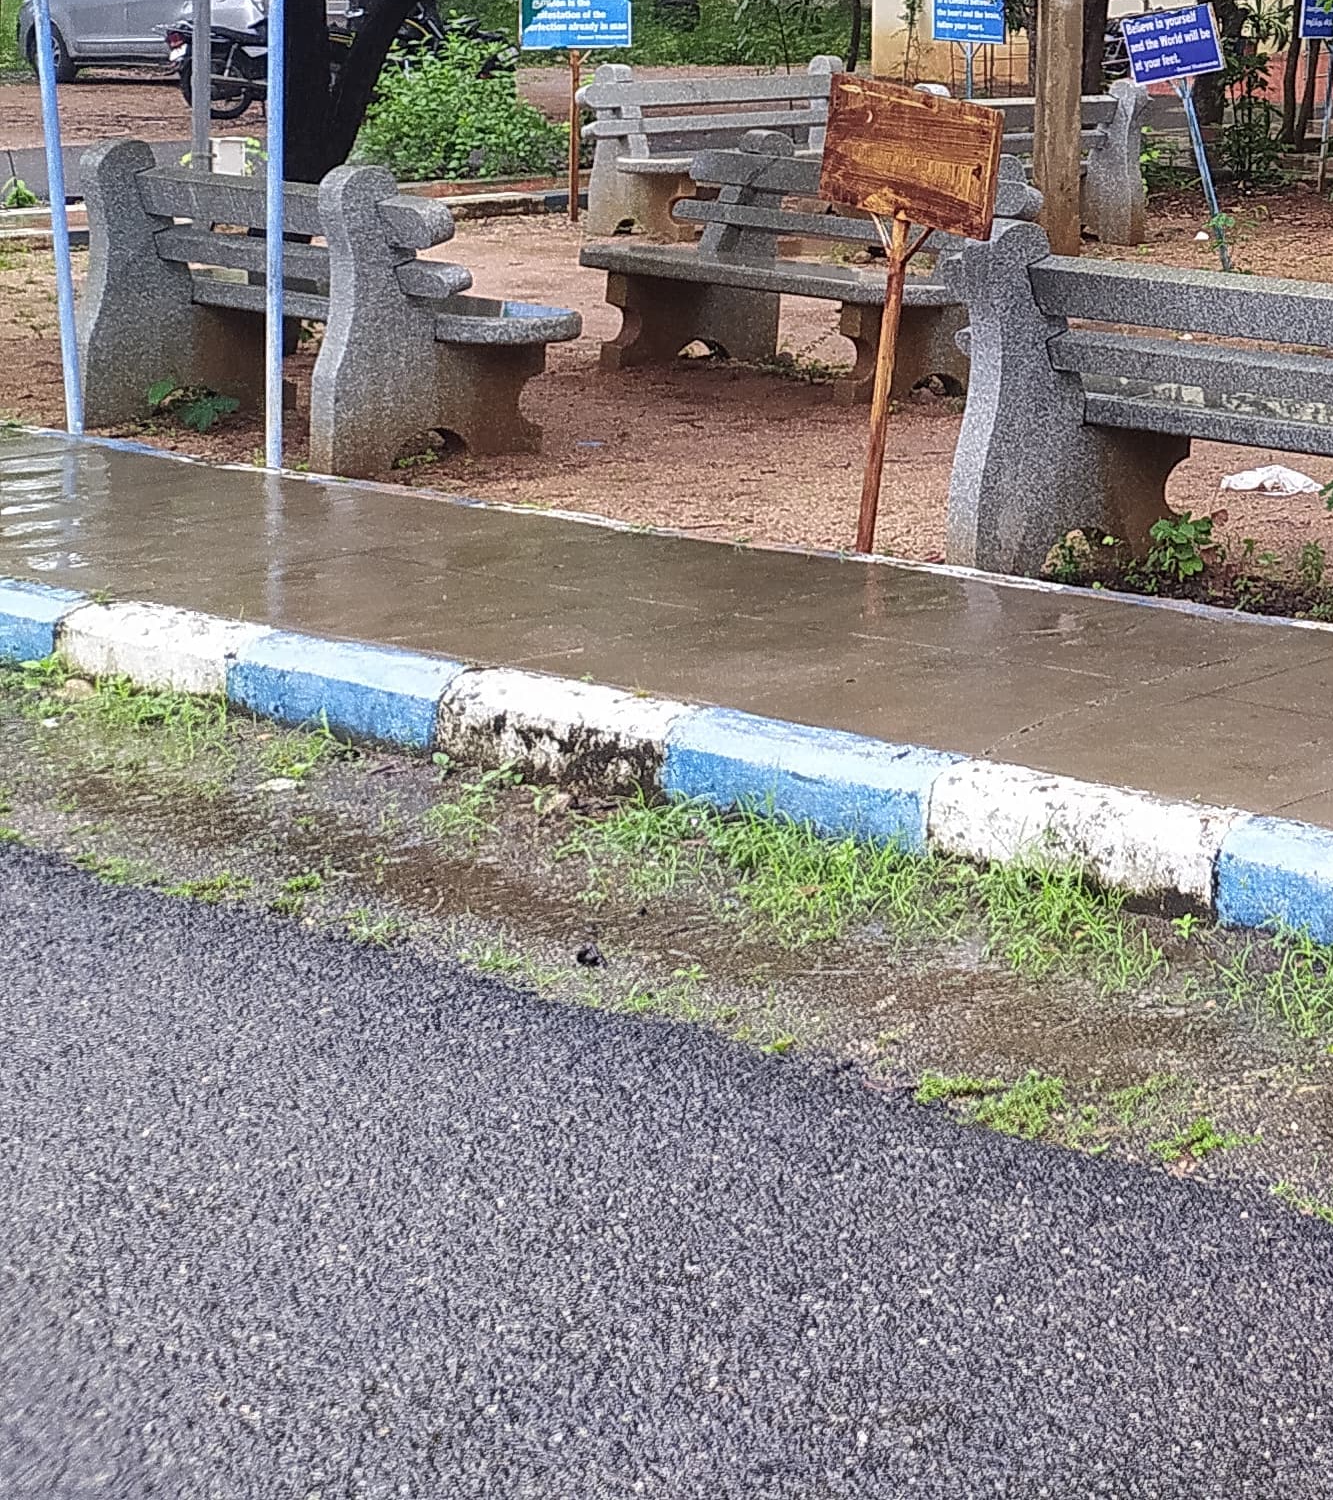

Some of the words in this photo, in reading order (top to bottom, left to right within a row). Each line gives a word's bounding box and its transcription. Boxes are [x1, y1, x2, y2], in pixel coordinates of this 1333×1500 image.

[1125, 21, 1154, 35] Believe
[1155, 18, 1165, 29] in
[1165, 11, 1196, 30] yourself
[1130, 41, 1145, 54] and
[1146, 38, 1159, 50] the
[1184, 29, 1199, 42] will
[1200, 28, 1211, 39] be
[1144, 57, 1162, 72] your
